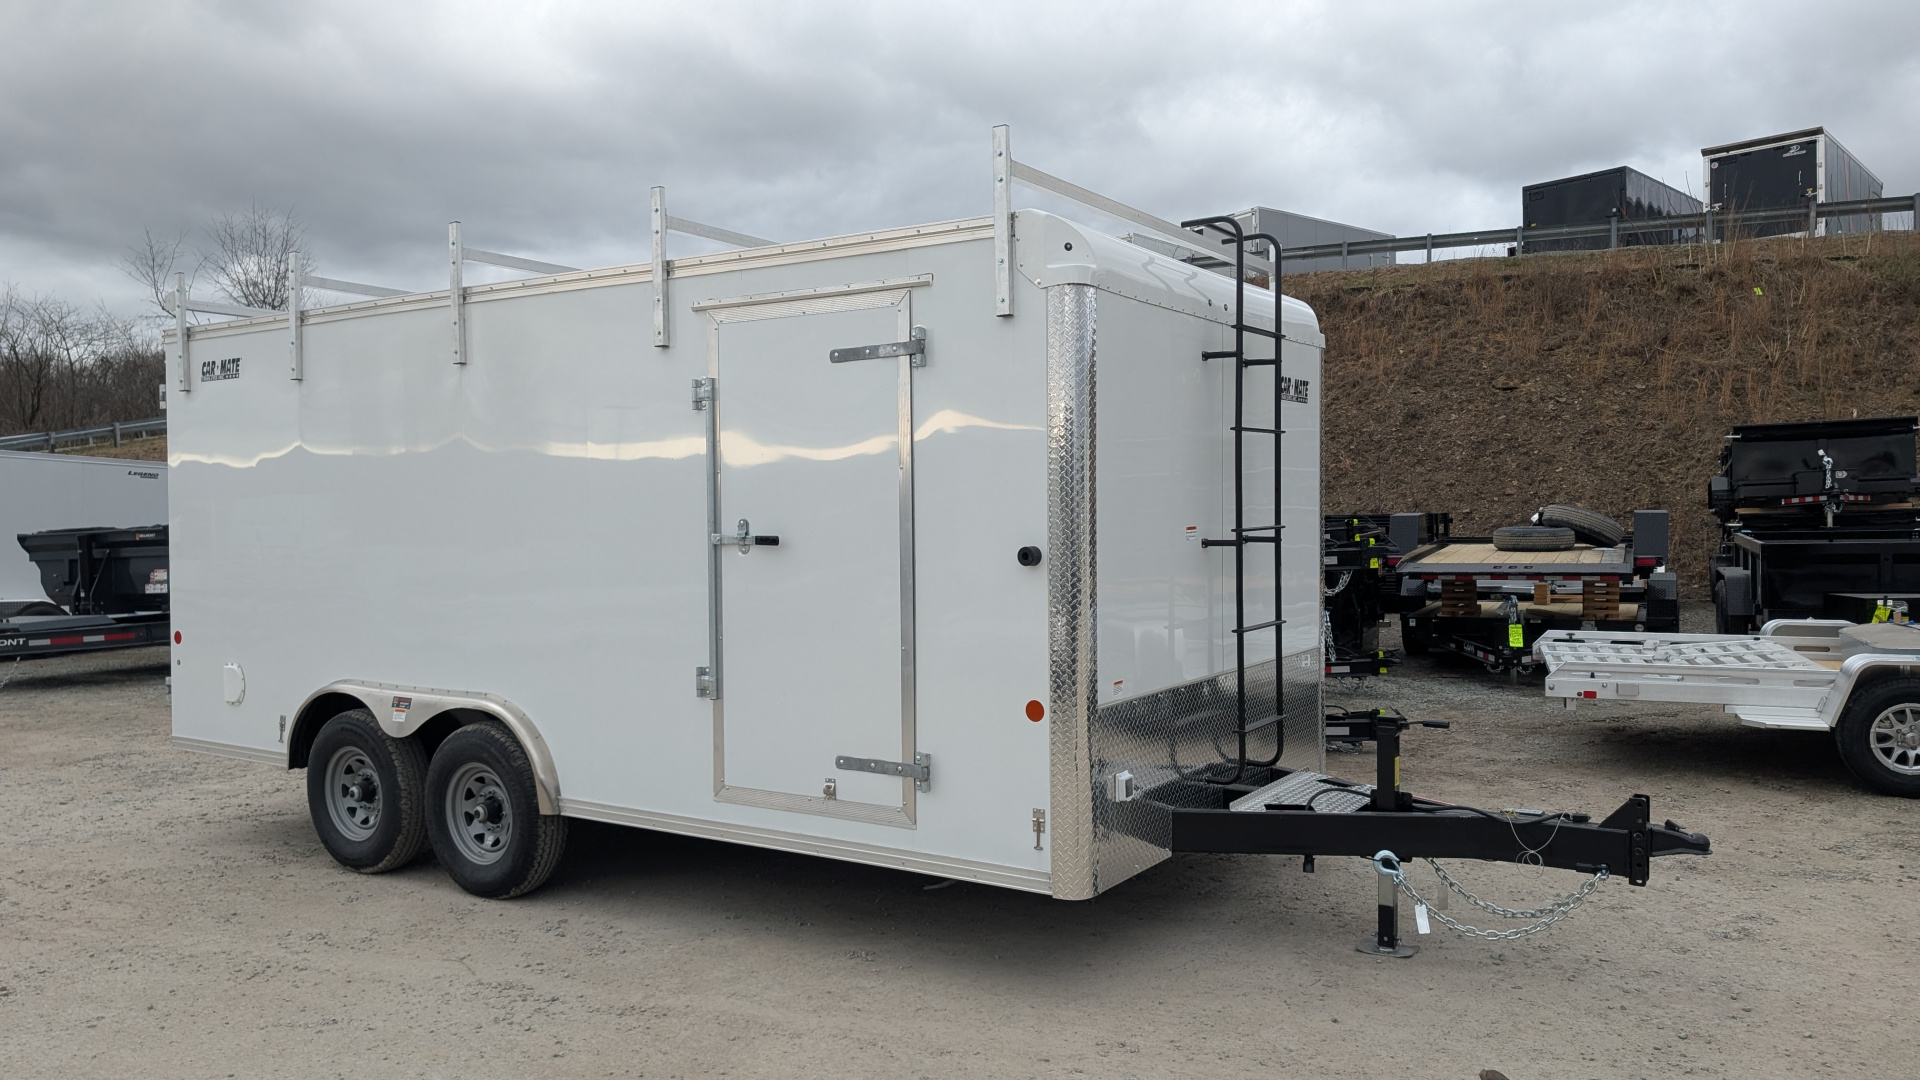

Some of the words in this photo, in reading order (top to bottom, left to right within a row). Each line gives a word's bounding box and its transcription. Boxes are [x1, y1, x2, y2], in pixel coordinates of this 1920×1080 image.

[201, 360, 216, 377] CAR
[220, 357, 241, 375] MATE
[1294, 378, 1309, 398] MATE
